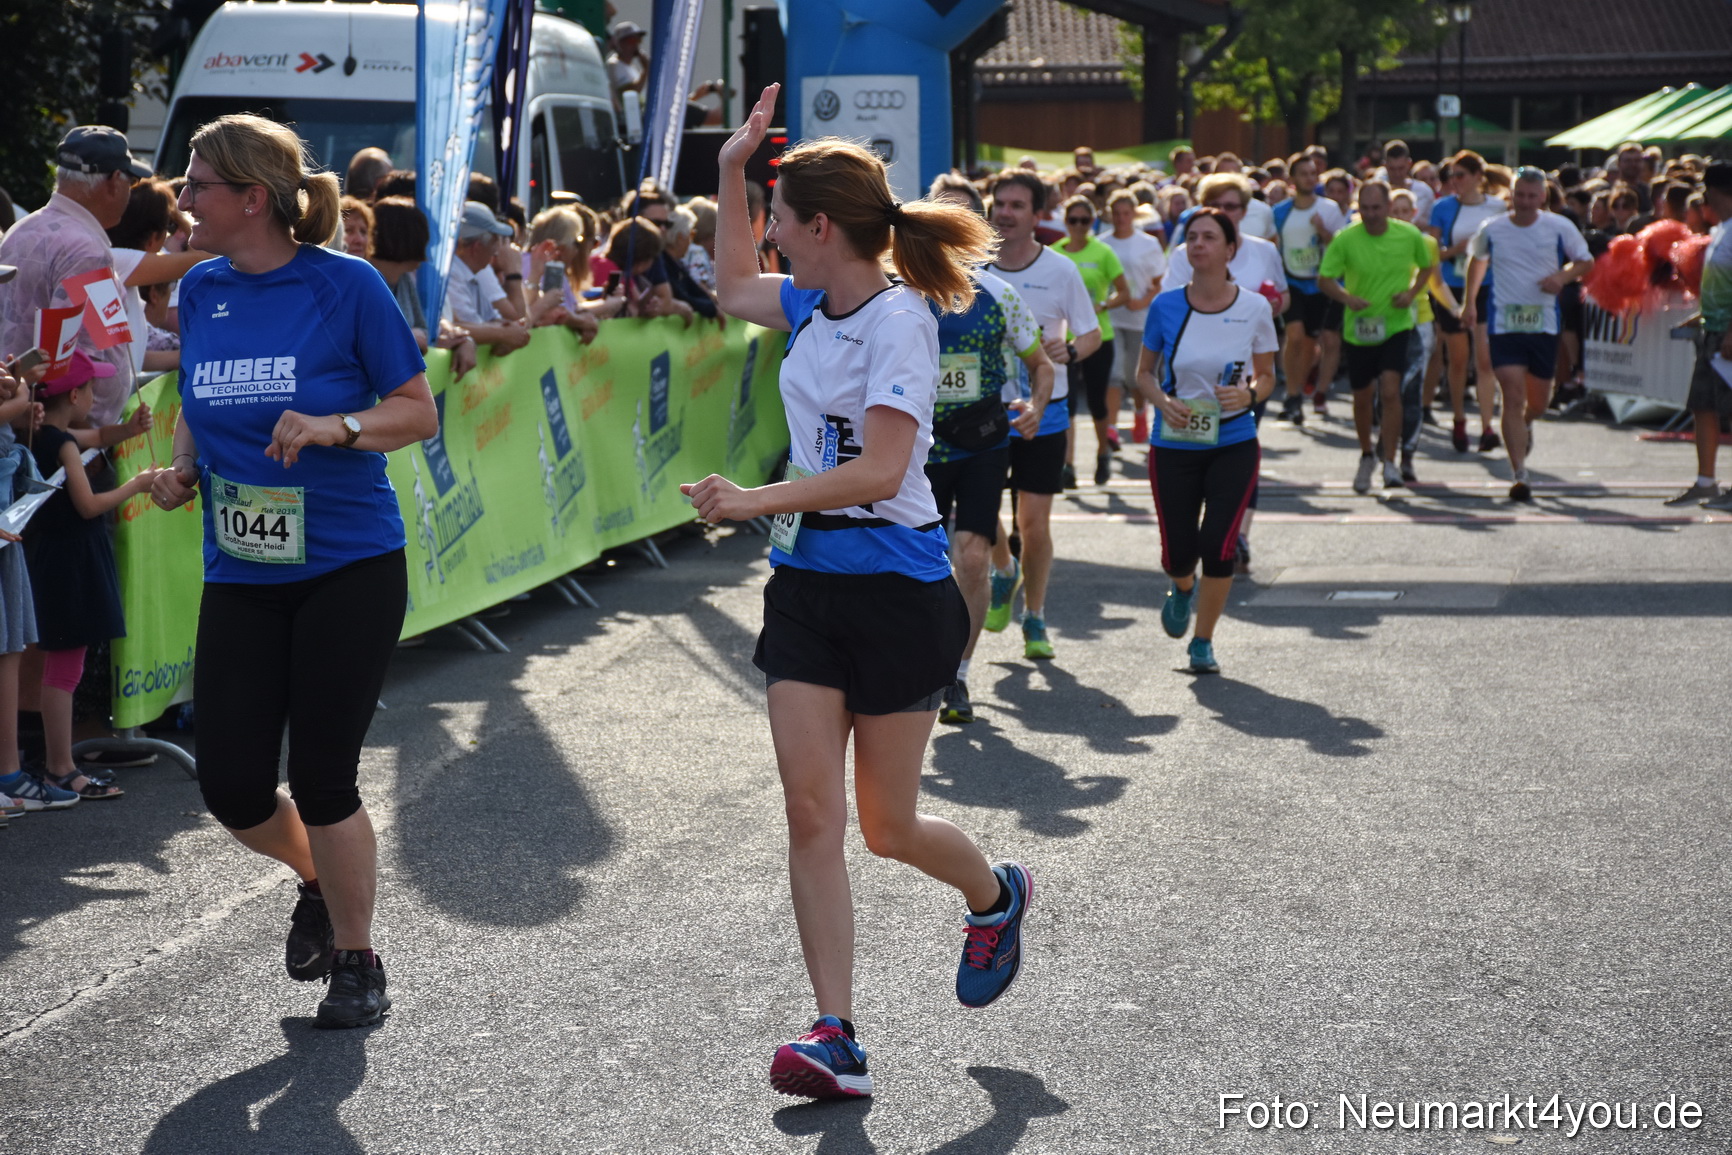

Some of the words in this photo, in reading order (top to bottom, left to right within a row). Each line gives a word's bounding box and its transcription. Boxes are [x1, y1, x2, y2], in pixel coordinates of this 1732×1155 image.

[204, 51, 290, 71] abavent
[212, 311, 229, 319] erima
[192, 356, 296, 386] HUBER
[210, 382, 291, 395] TECHNOLOGY
[209, 398, 233, 406] WASTE
[235, 396, 259, 405] WATER
[260, 395, 293, 403] Solutions
[276, 507, 297, 515] 2019
[220, 506, 290, 543] 1044
[223, 533, 262, 549] Großhauser
[264, 542, 286, 551] Heidi
[237, 546, 256, 555] HUBER
